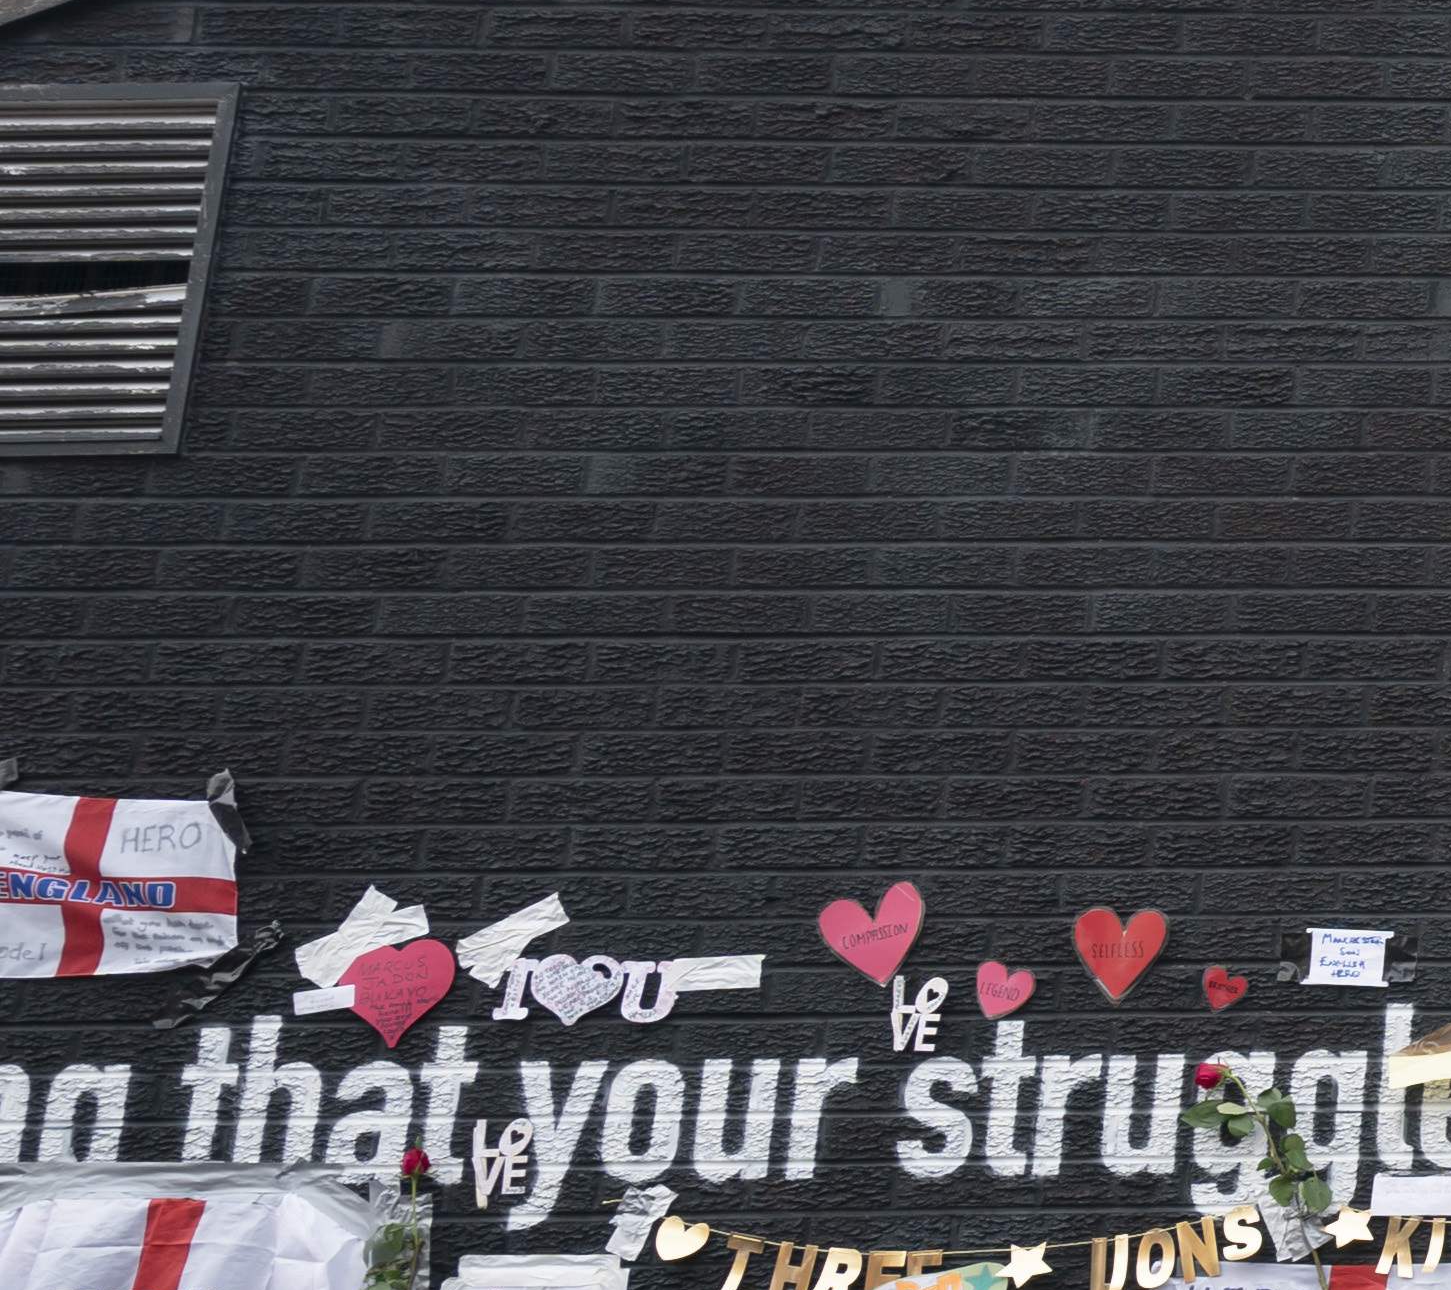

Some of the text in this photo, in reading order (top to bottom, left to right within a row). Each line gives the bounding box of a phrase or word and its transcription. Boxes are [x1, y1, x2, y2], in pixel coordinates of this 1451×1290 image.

[121, 822, 201, 854] HERO
[841, 921, 910, 950] COMPASSION
[1090, 938, 1146, 961] SELFLESS
[979, 980, 1021, 1003] LEGEND
[181, 1016, 480, 1185] that
[508, 1058, 860, 1231] your
